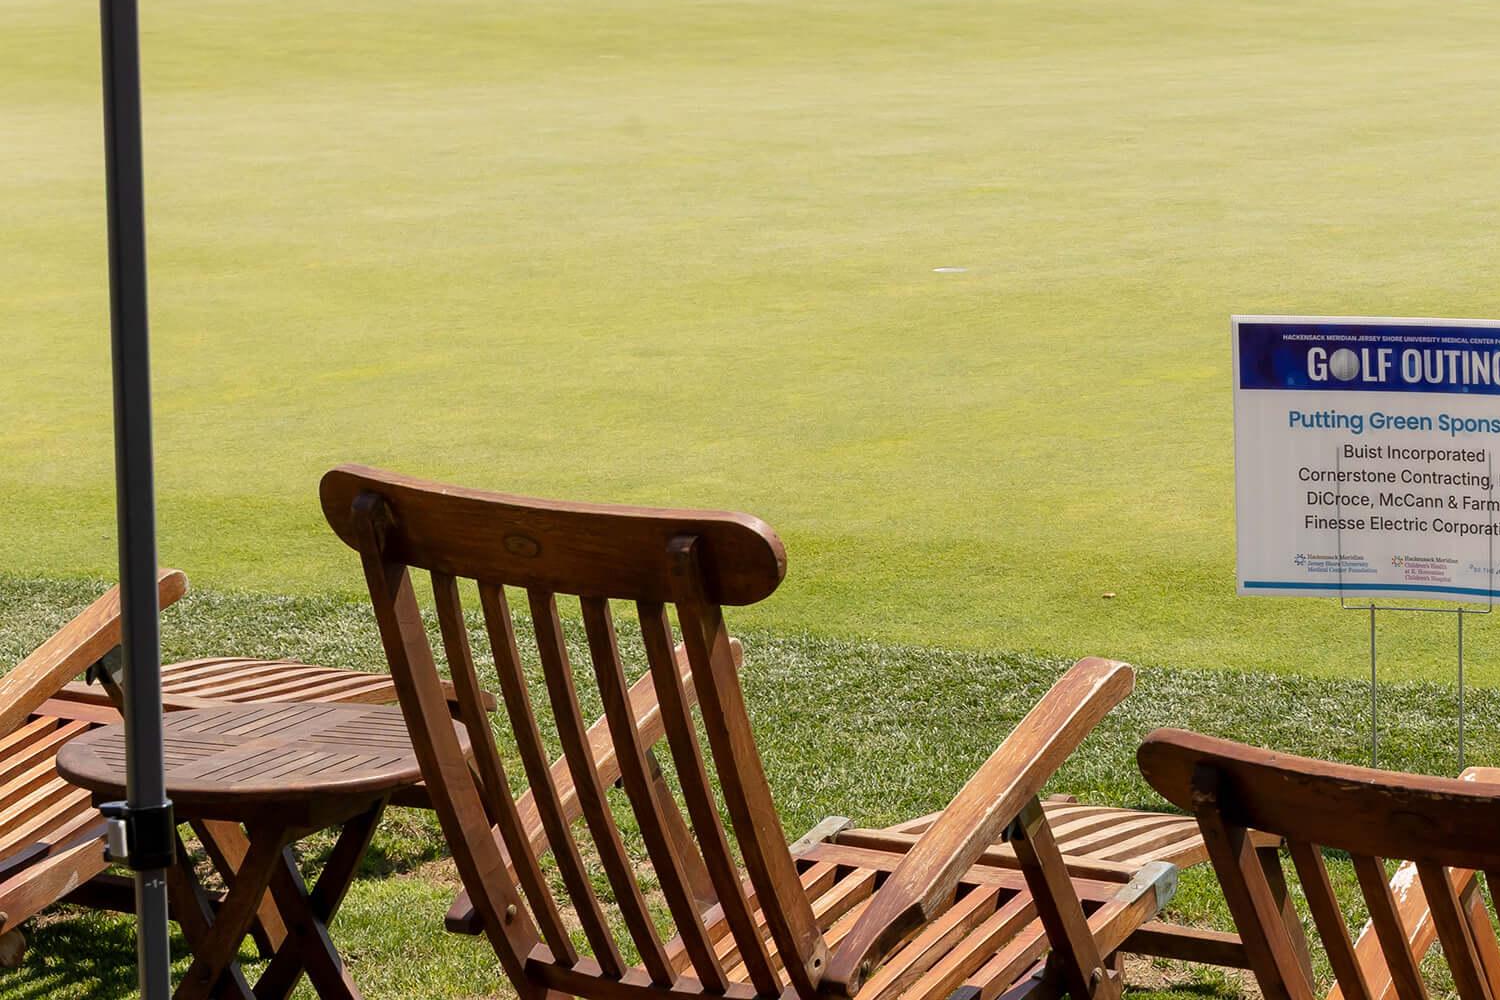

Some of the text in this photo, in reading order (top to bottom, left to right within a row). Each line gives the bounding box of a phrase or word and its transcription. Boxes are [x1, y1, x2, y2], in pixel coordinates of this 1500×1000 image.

[1289, 410, 1364, 434] Putting
[1369, 412, 1433, 430] Green
[1344, 444, 1485, 463] Buist Incorporated
[1298, 467, 1396, 482] Cornerstone
[1401, 469, 1494, 490] Contracting,
[1307, 491, 1374, 509] DiCroce,
[1379, 492, 1443, 508] McCann
[1448, 495, 1458, 509] &
[1305, 515, 1365, 530] Finesse
[1370, 516, 1428, 532] Electric
